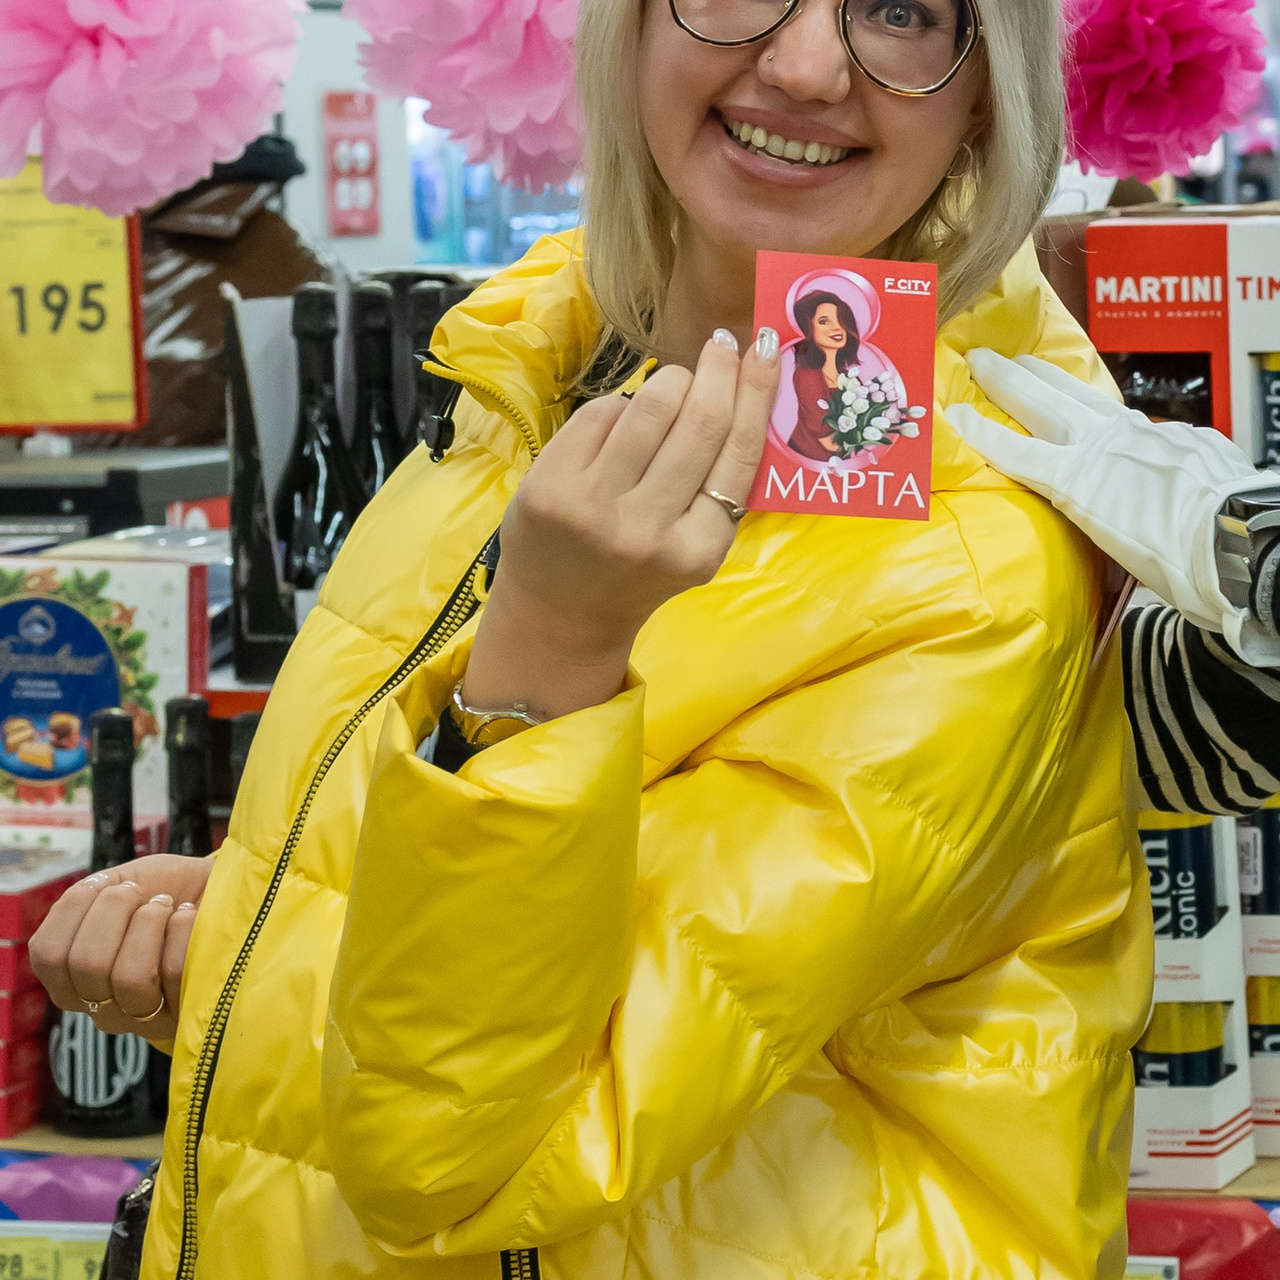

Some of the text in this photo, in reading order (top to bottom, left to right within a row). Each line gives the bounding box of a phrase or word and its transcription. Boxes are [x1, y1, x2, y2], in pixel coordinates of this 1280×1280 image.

[884, 277, 931, 291] F CITY
[1095, 275, 1222, 303] MARTINI
[9, 282, 106, 335] 195
[764, 464, 926, 509] МАРТА
